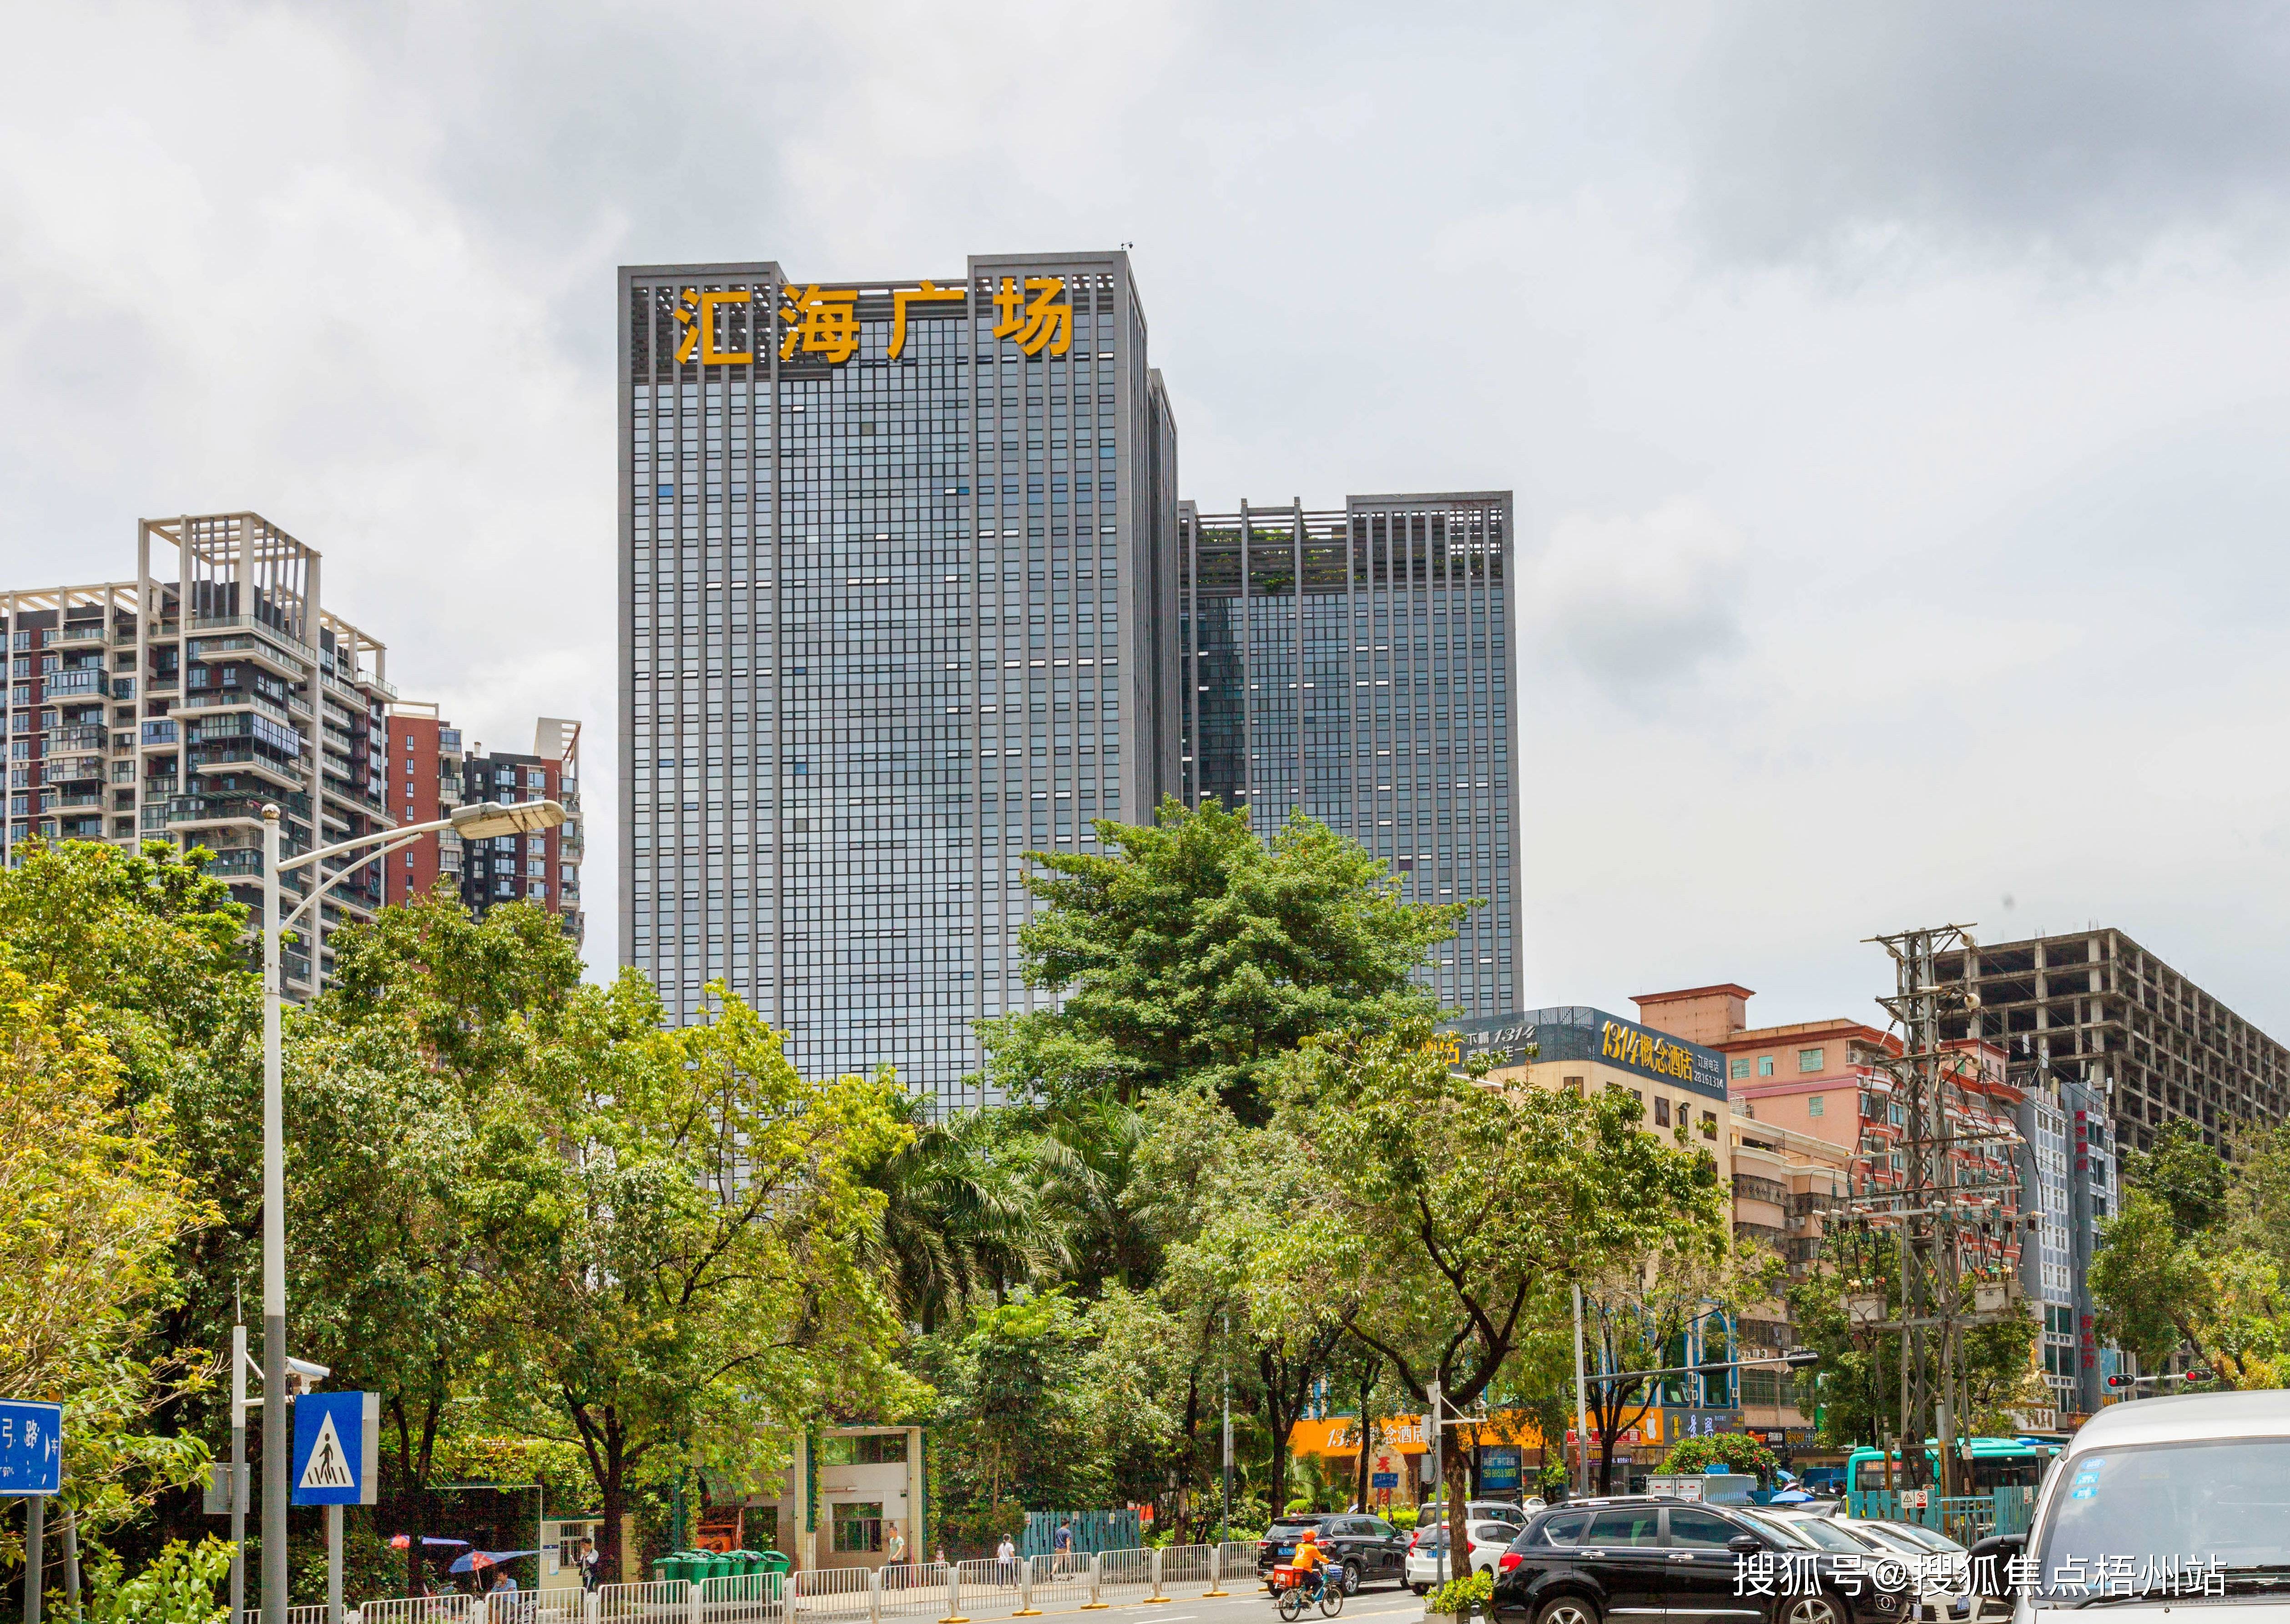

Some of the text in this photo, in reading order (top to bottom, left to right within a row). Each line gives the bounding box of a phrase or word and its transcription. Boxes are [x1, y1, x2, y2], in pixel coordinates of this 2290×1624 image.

[674, 279, 1073, 365] 汇海广场
[1466, 1025, 1536, 1045] 下榻 1314
[1602, 1020, 1695, 1082] 1314概念酒店
[1697, 1055, 1720, 1074] 订房电话
[1694, 1070, 1724, 1090] 28161314
